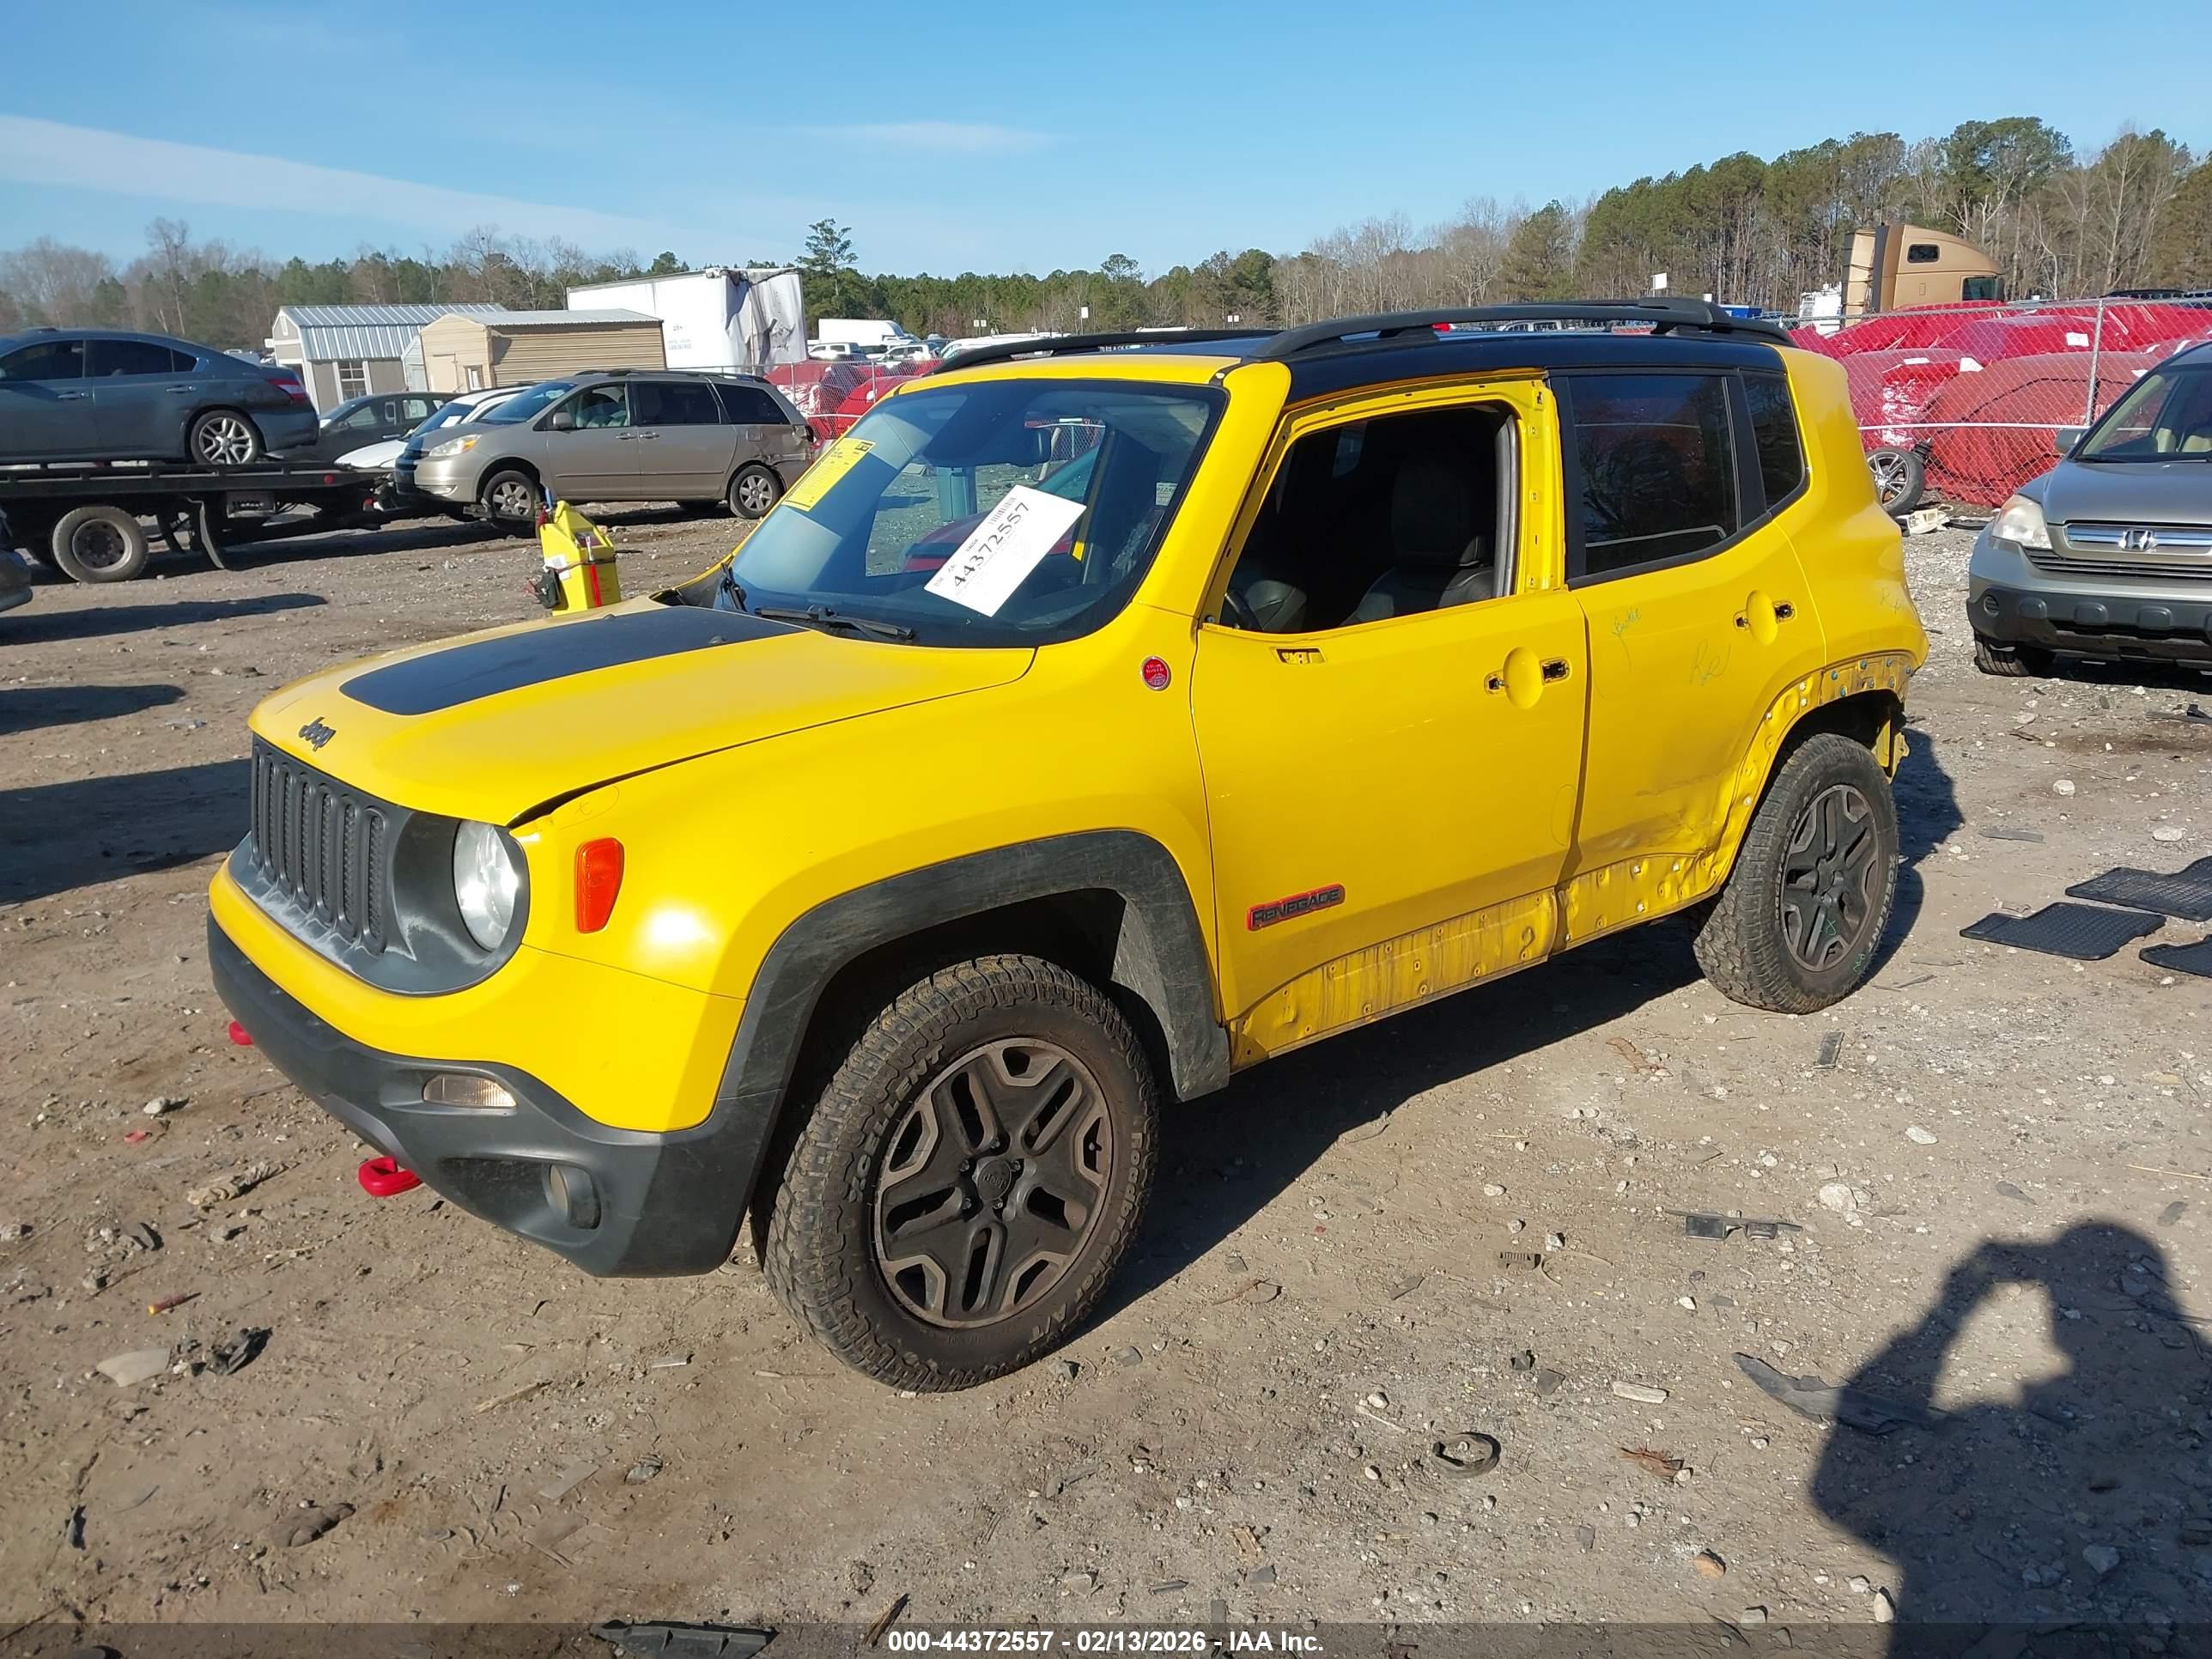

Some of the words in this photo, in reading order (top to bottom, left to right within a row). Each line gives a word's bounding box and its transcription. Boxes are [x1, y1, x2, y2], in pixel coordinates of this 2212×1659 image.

[954, 501, 1030, 587] 44372557
[298, 716, 337, 752] Jeep
[1253, 888, 1340, 924] RENEGADE
